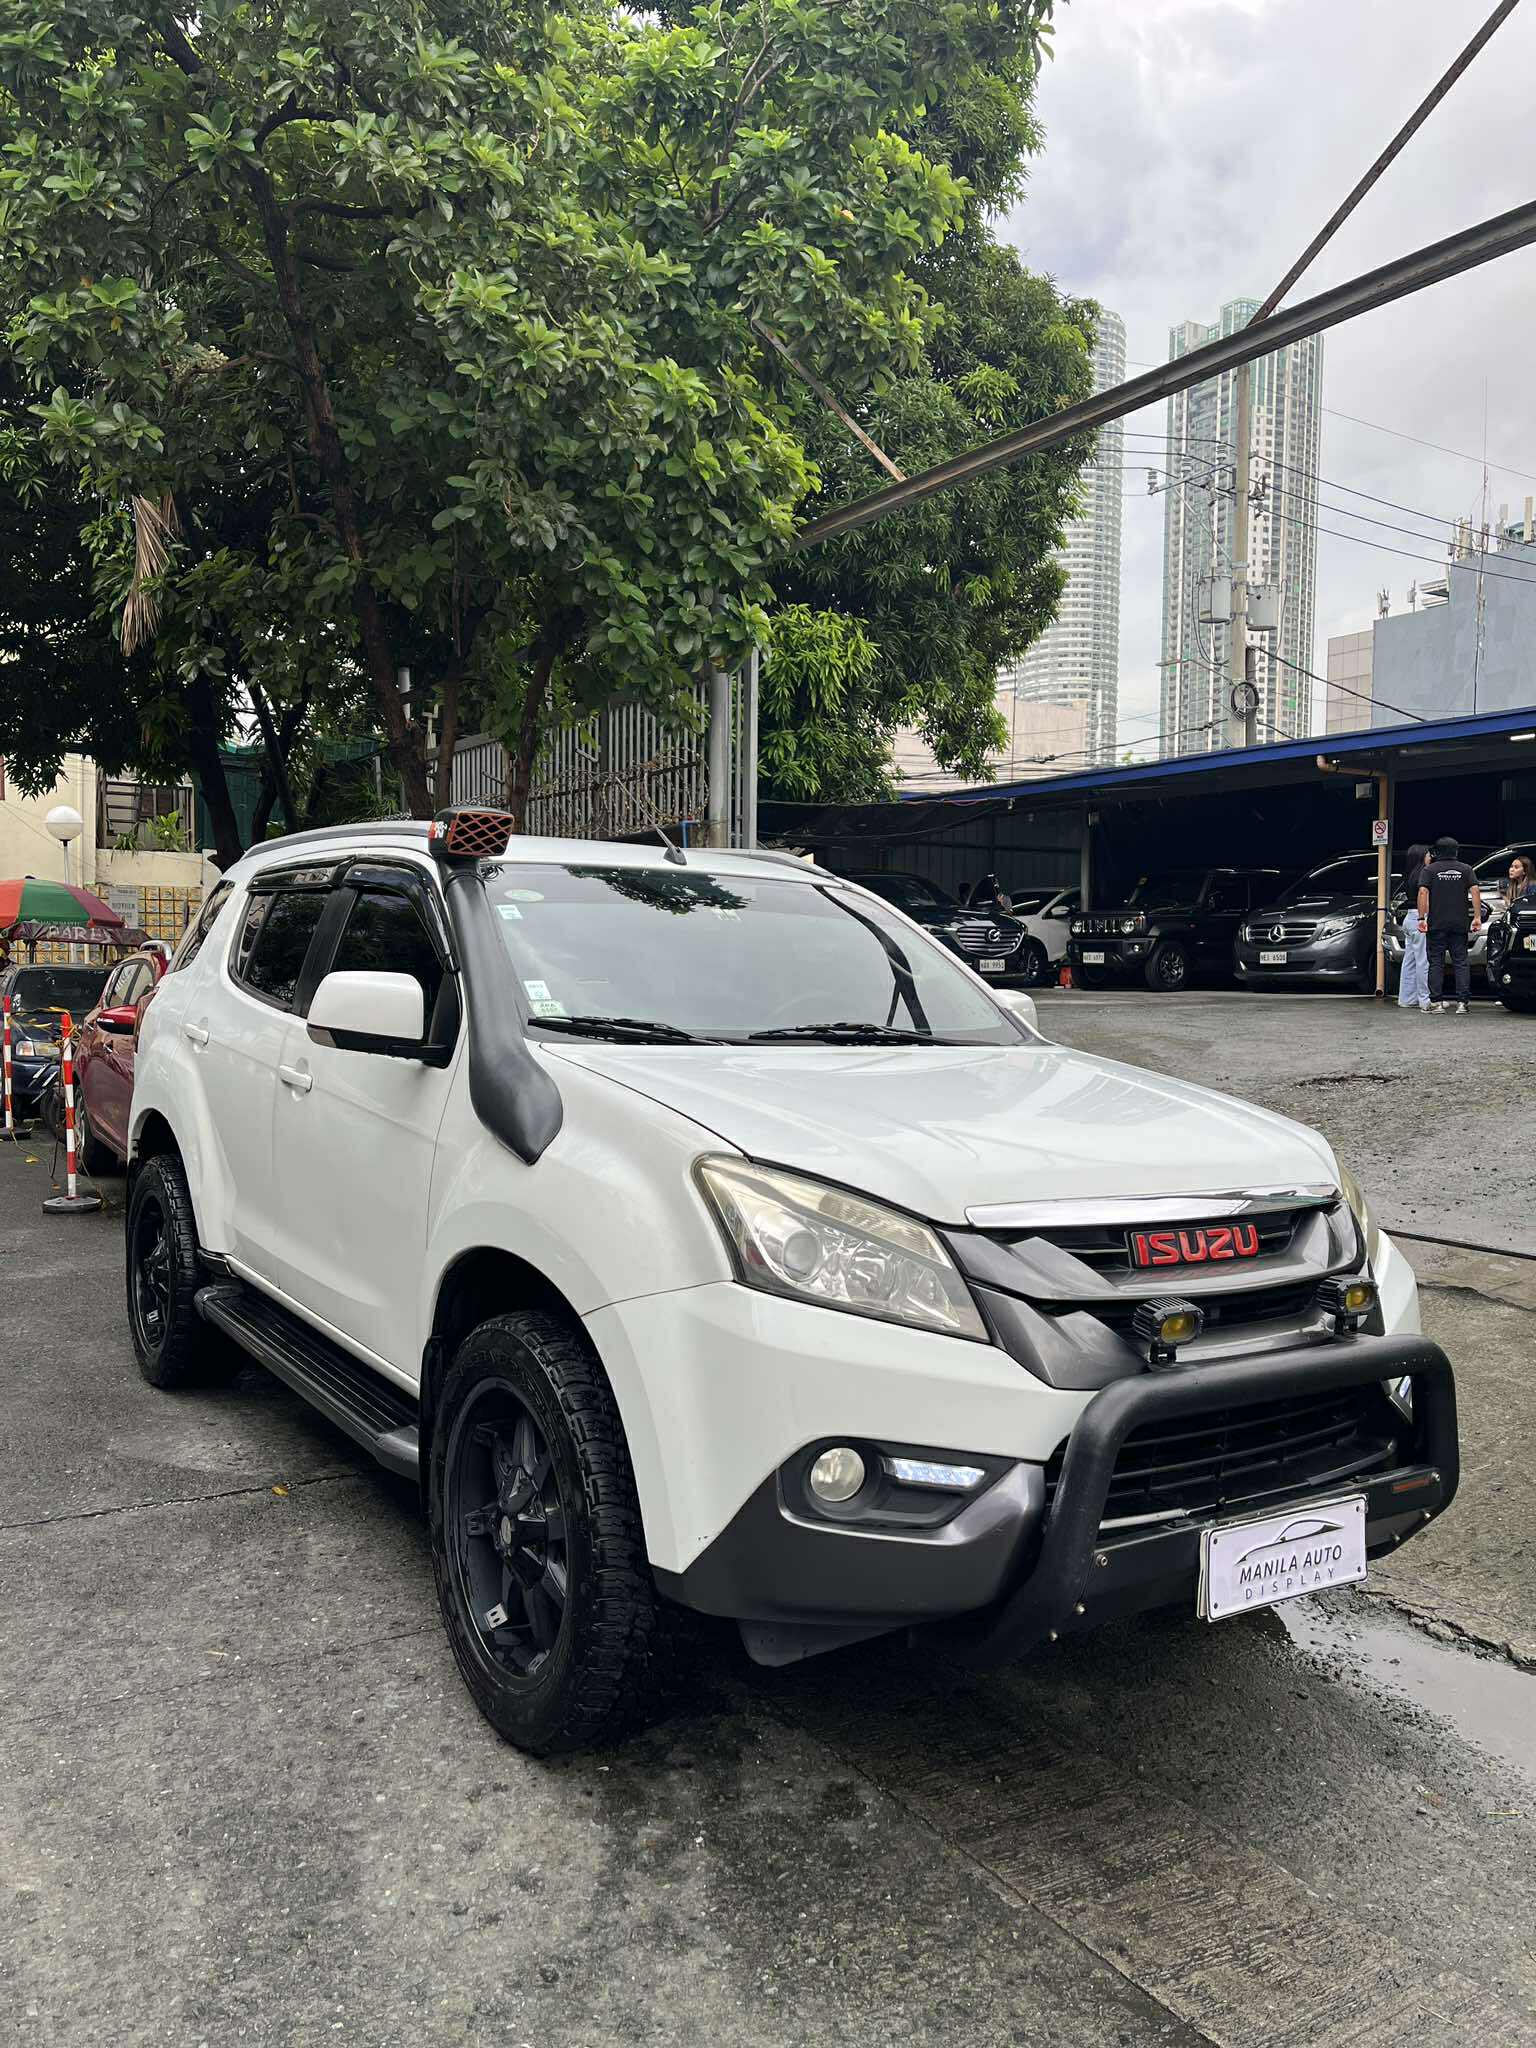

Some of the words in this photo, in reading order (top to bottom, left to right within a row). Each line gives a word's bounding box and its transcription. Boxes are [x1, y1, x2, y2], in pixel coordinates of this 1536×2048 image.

[1135, 1224, 1259, 1266] ISUZU
[1239, 1554, 1298, 1585] MANILA
[1303, 1544, 1343, 1568] AUTO
[1245, 1567, 1336, 1600] DISPLAY
